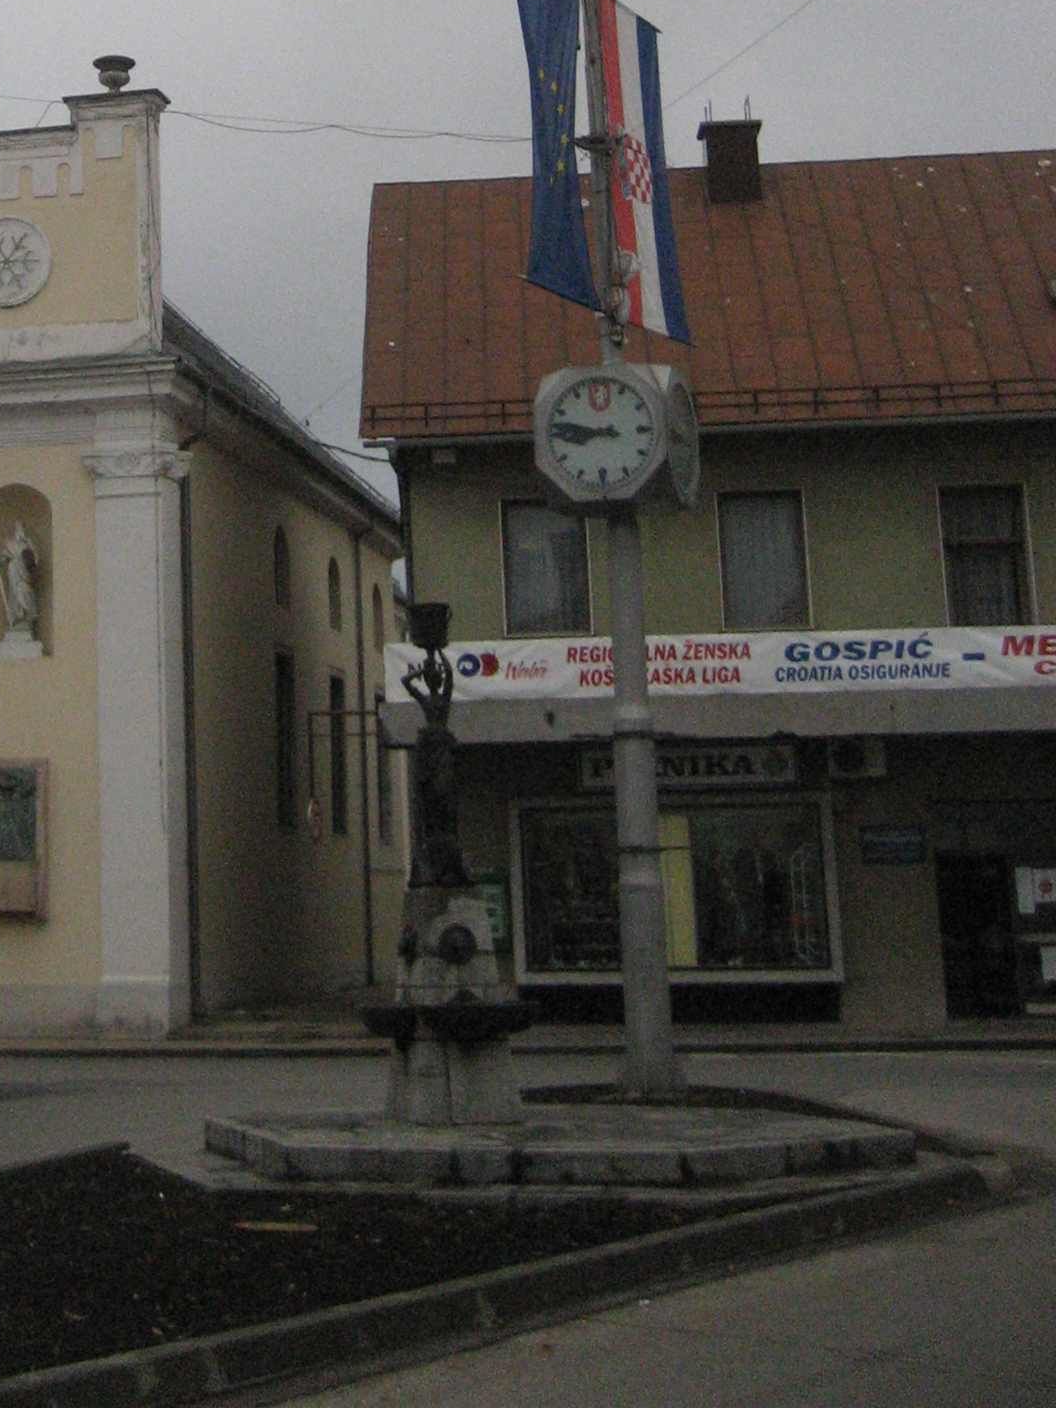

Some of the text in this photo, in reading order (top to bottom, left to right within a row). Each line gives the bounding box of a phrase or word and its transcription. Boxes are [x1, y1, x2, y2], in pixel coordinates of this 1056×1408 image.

[682, 640, 751, 660] ŽENSKA
[784, 631, 933, 662] GOSPIĆ
[702, 666, 741, 684] LIGA
[775, 662, 951, 682] CROATIA OSIGURANJE
